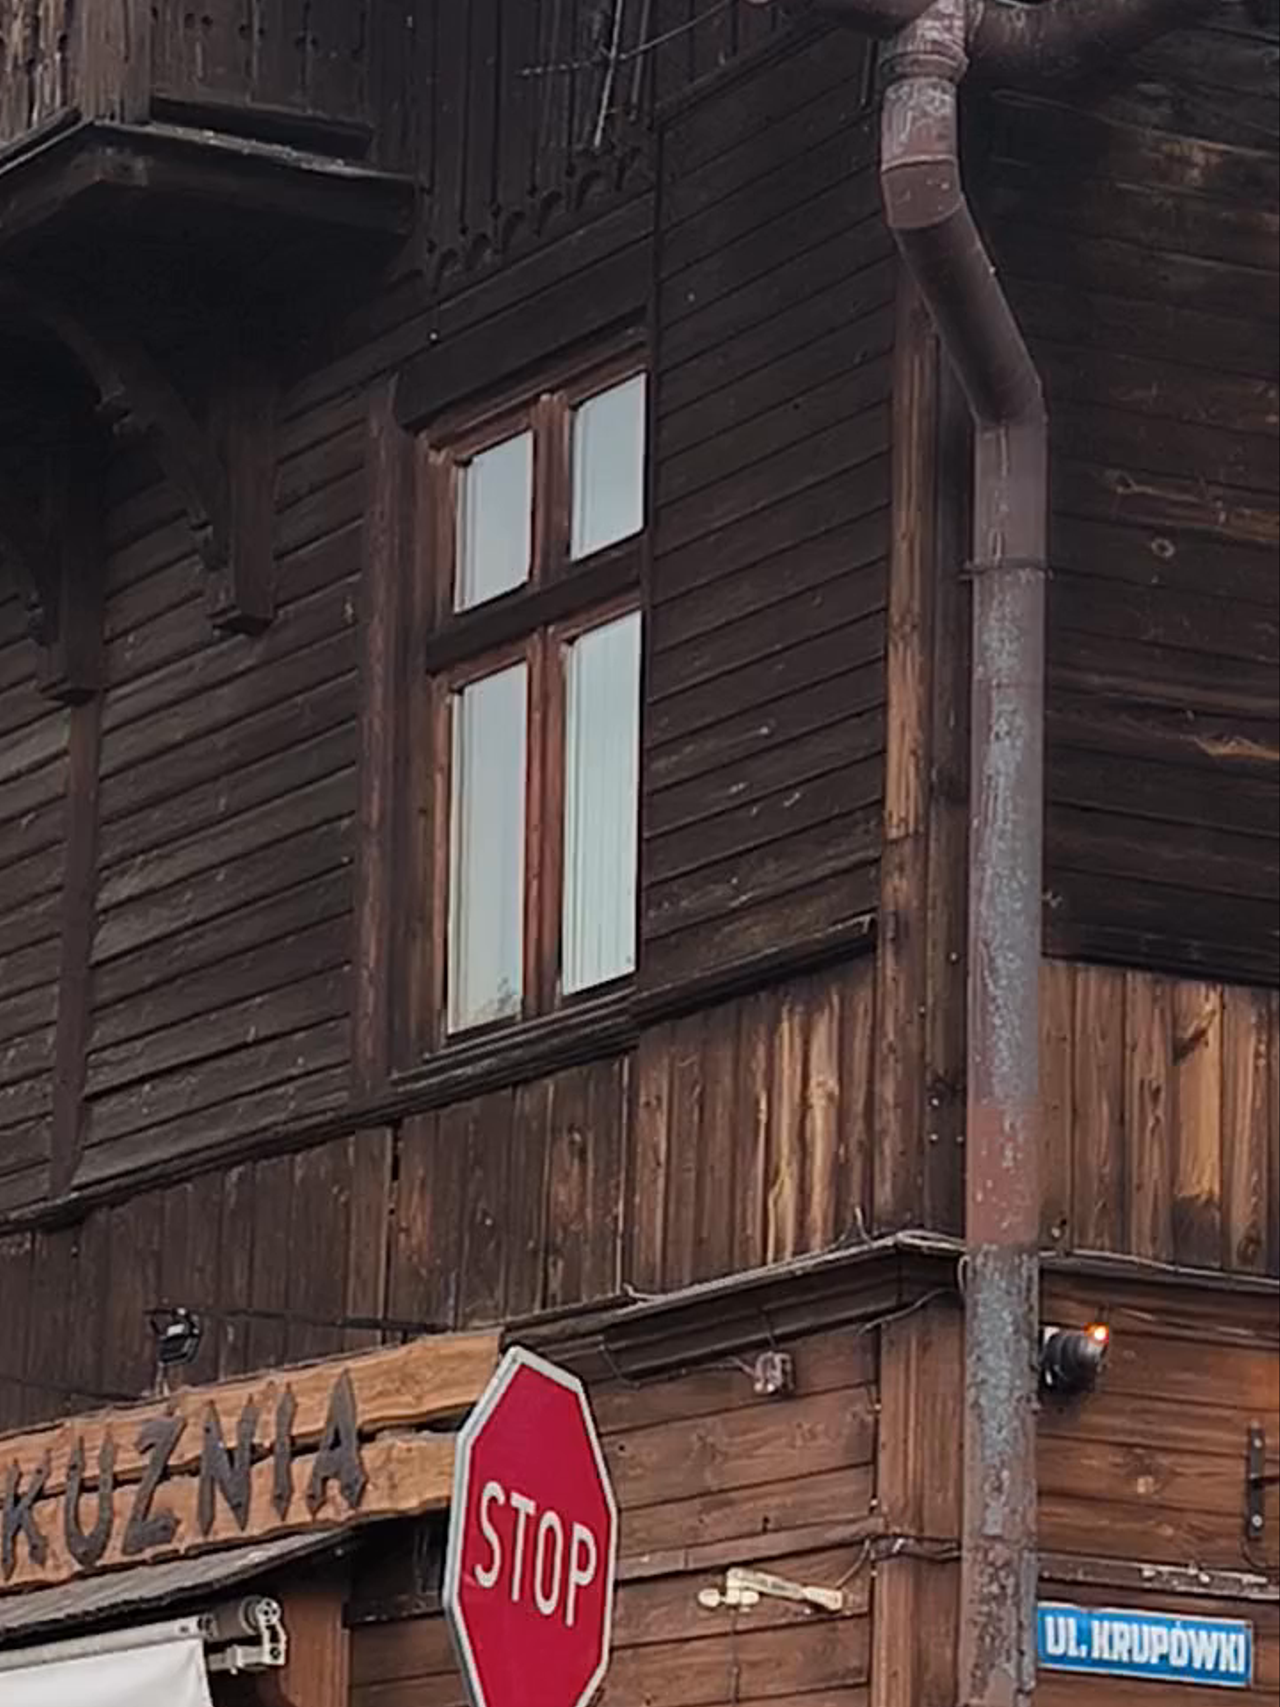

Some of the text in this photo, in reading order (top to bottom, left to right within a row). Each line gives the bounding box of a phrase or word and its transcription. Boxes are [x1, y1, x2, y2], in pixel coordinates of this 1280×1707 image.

[473, 1480, 598, 1628] STOP
[1045, 1615, 1245, 1673] UL. KRUPÓWKI
